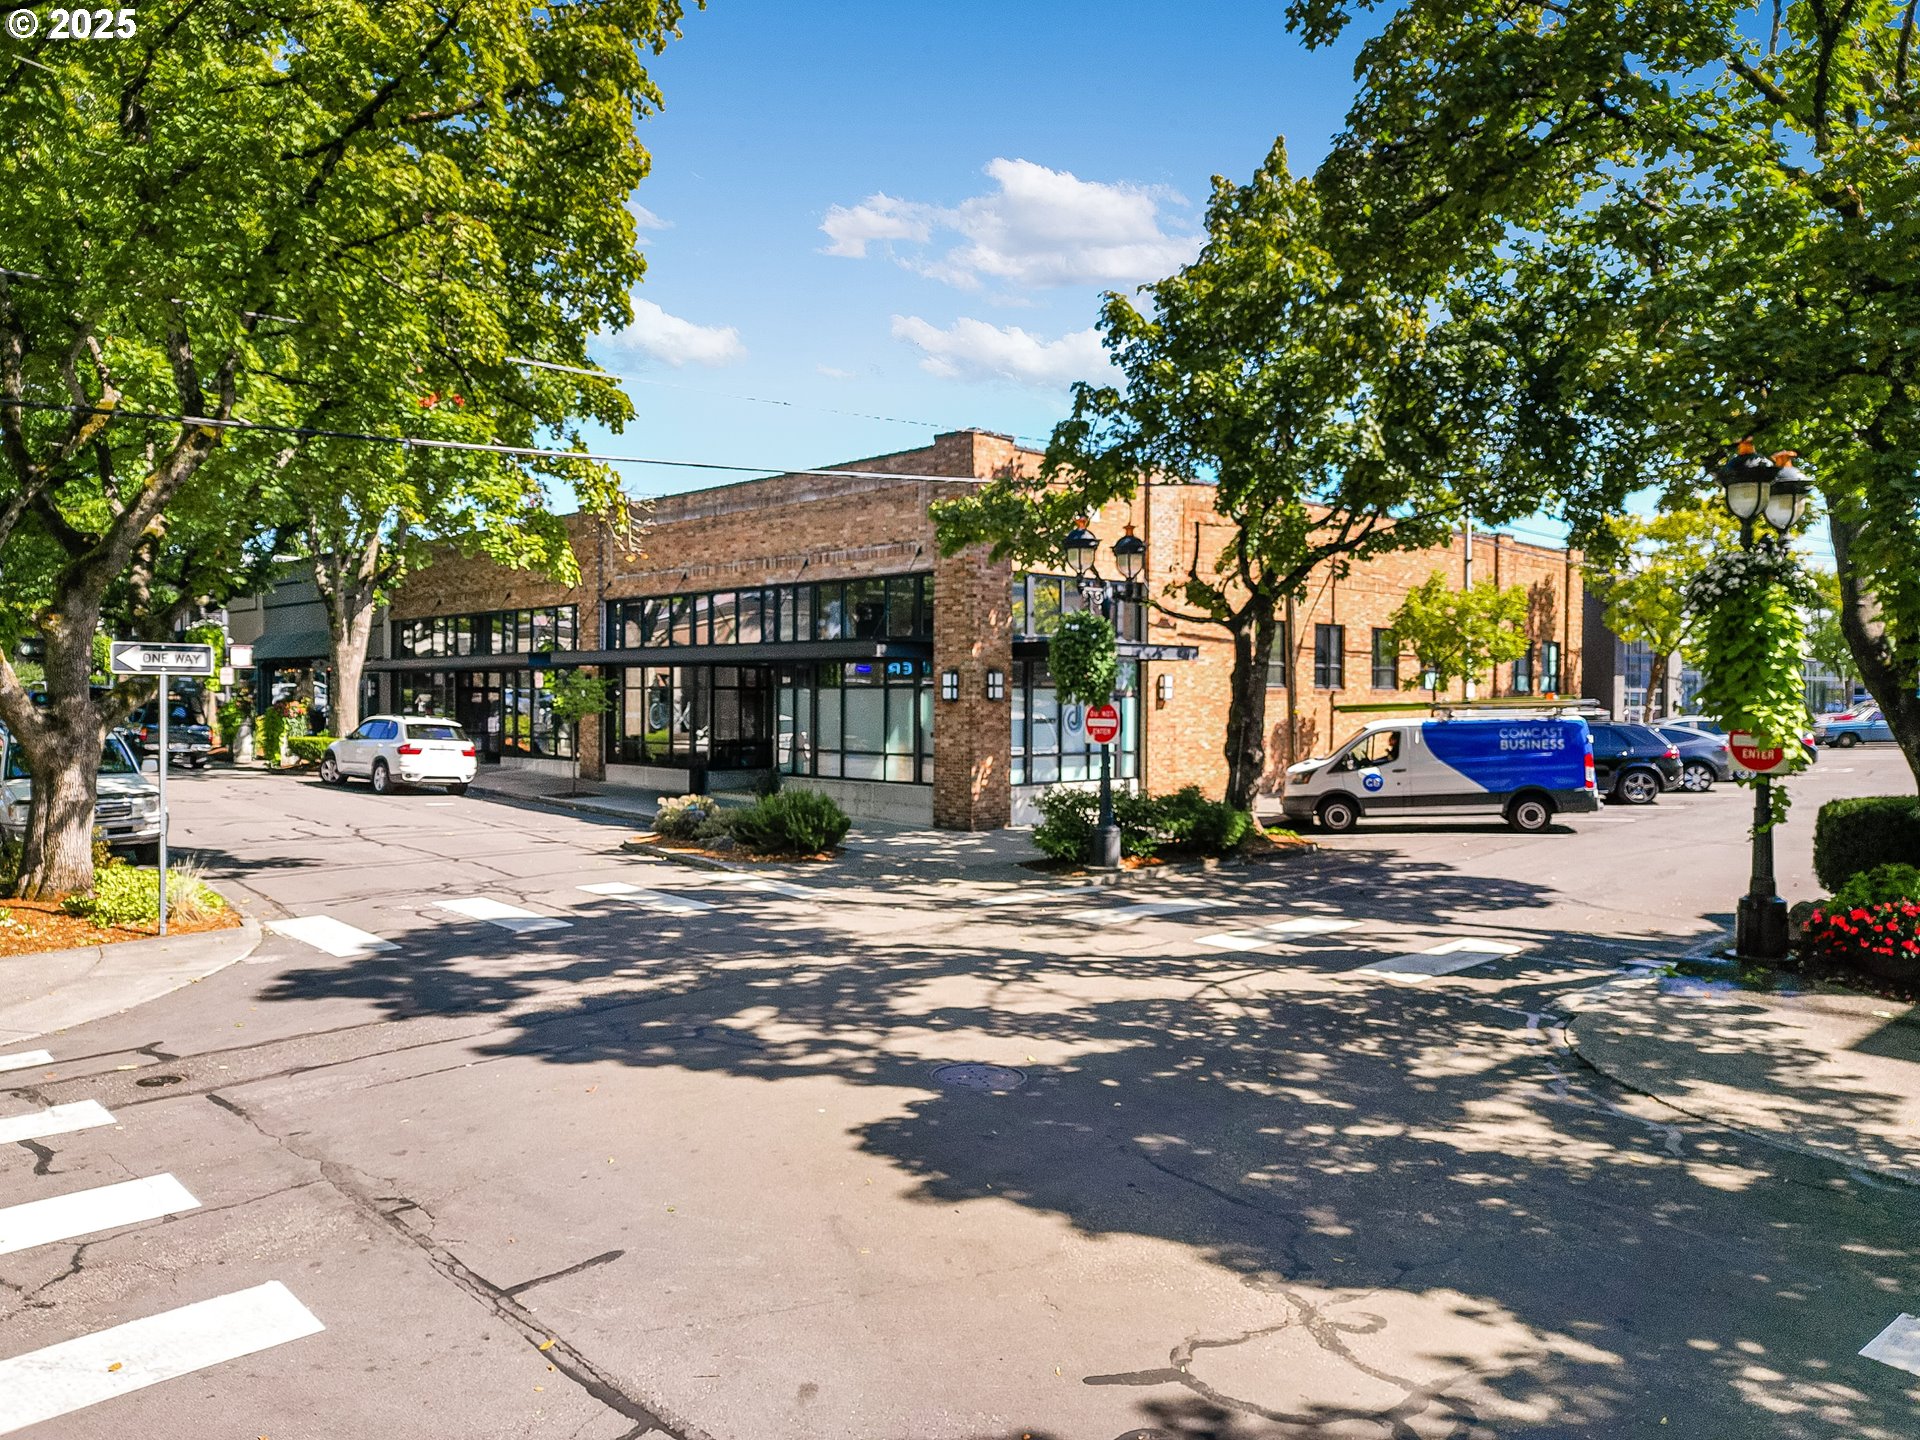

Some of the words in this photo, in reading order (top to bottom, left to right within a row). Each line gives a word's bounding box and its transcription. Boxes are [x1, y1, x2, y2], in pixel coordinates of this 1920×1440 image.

[143, 653, 168, 664] ONE
[174, 654, 202, 664] WAY
[1101, 710, 1114, 718] NOT
[1092, 728, 1112, 736] ENTER
[1499, 727, 1564, 739] COMCAST
[1500, 738, 1565, 750] BUSINESS
[1742, 748, 1775, 760] ENTER
